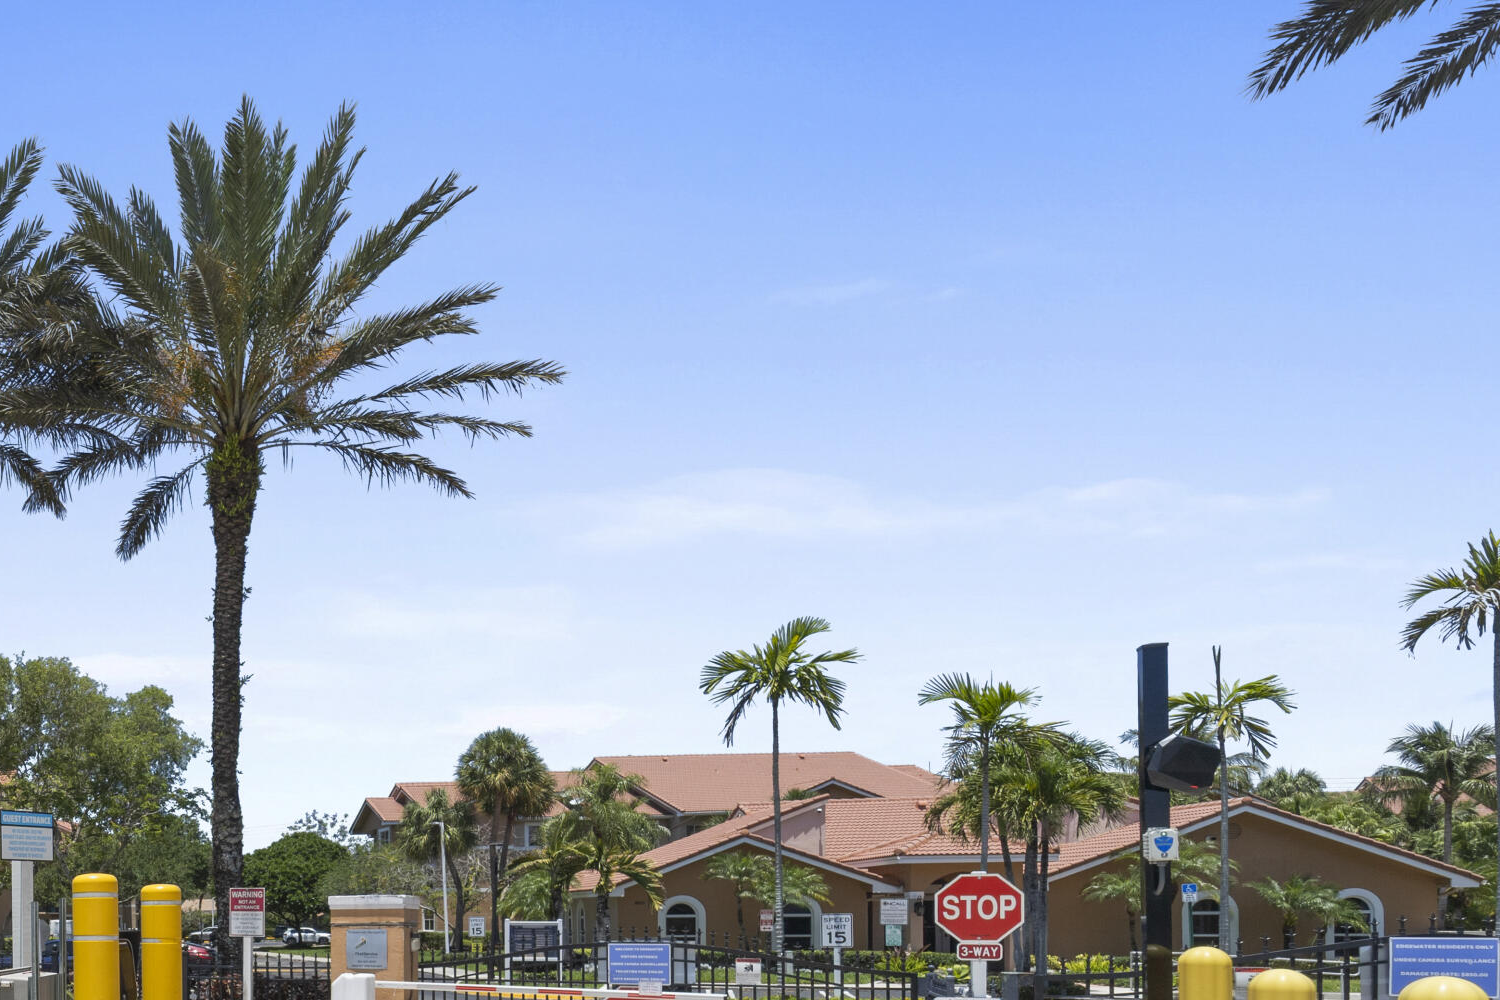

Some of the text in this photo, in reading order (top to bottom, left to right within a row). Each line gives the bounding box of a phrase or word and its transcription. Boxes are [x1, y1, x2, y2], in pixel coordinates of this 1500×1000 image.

[3, 814, 51, 824] GUEST ENTRANCE
[942, 894, 1017, 920] STOP
[827, 931, 847, 944] 15
[960, 946, 998, 957] 3-WAY
